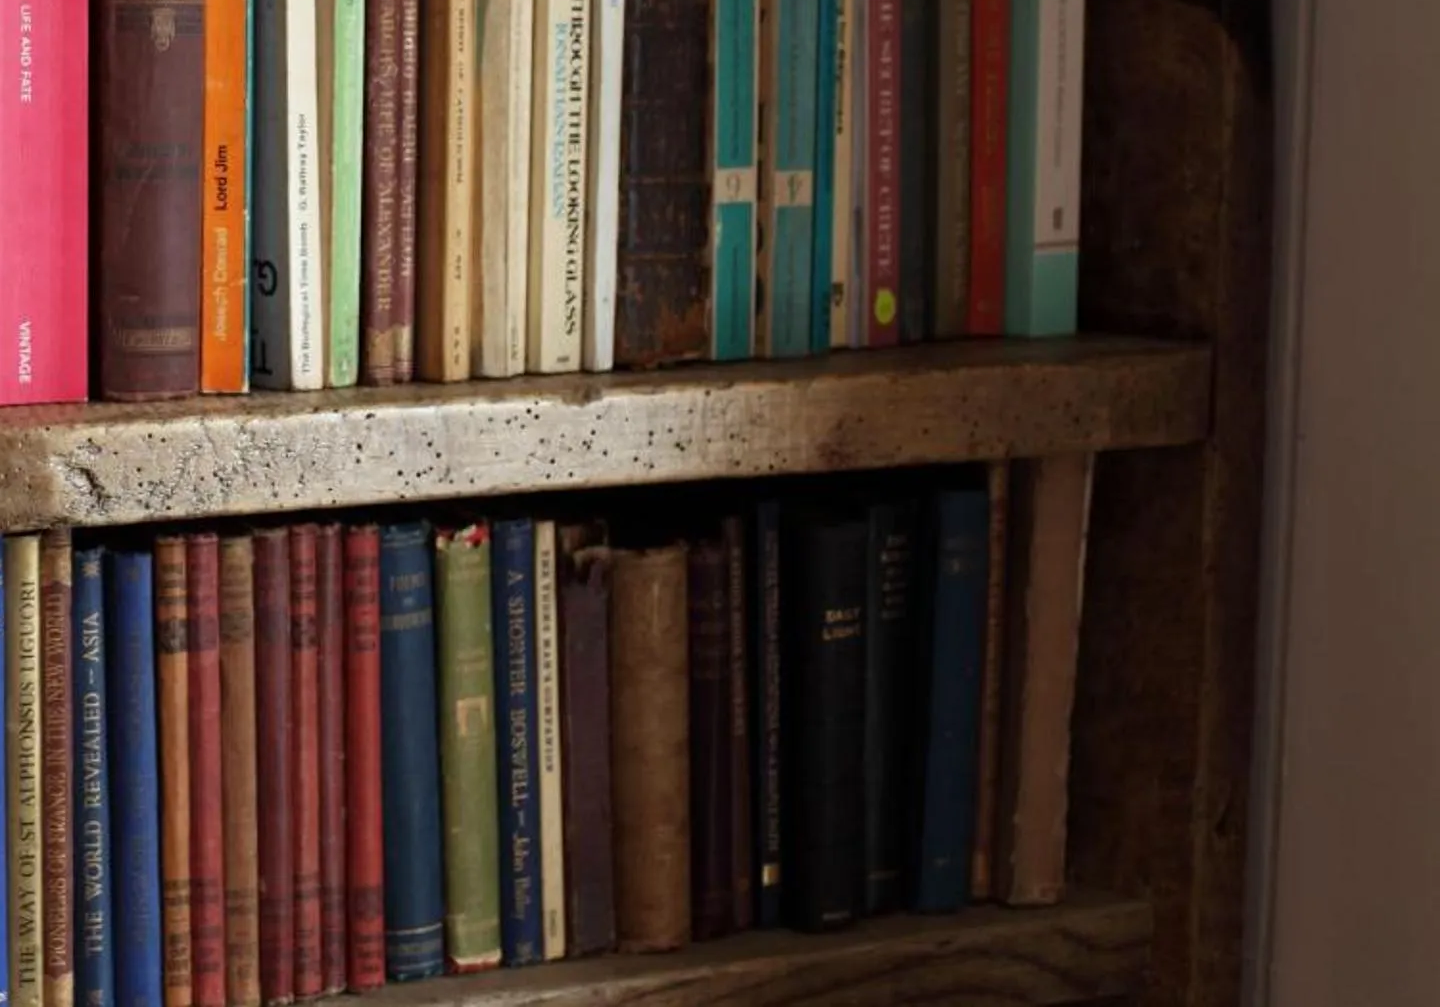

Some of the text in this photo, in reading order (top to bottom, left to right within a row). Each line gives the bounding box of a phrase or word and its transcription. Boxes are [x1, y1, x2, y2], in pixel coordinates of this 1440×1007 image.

[20, 4, 32, 32] LIFE
[20, 36, 32, 66] AND
[20, 71, 32, 103] FATE
[296, 113, 307, 150] Taylor
[378, 146, 394, 174] OF
[567, 107, 582, 154] THE
[213, 145, 228, 212] Lord Jim
[565, 159, 581, 255] LOOKING
[376, 181, 396, 312] ALEXANDER
[213, 227, 229, 342] Joseph Conrad
[564, 264, 578, 336] GLASS
[18, 320, 32, 384] VINTAGE
[299, 353, 310, 374] The
[507, 570, 524, 587] A
[507, 594, 527, 697] SHORTER
[19, 579, 35, 989] THE WAY OF ST ALPHONSUS LIGUORI
[45, 592, 69, 967] PIONEERS OF FRANCE IN THE NEW WORLD
[81, 611, 104, 957] THE WORLD REVEALED ASIA
[510, 708, 530, 808] BOSWELL
[512, 830, 533, 872] John
